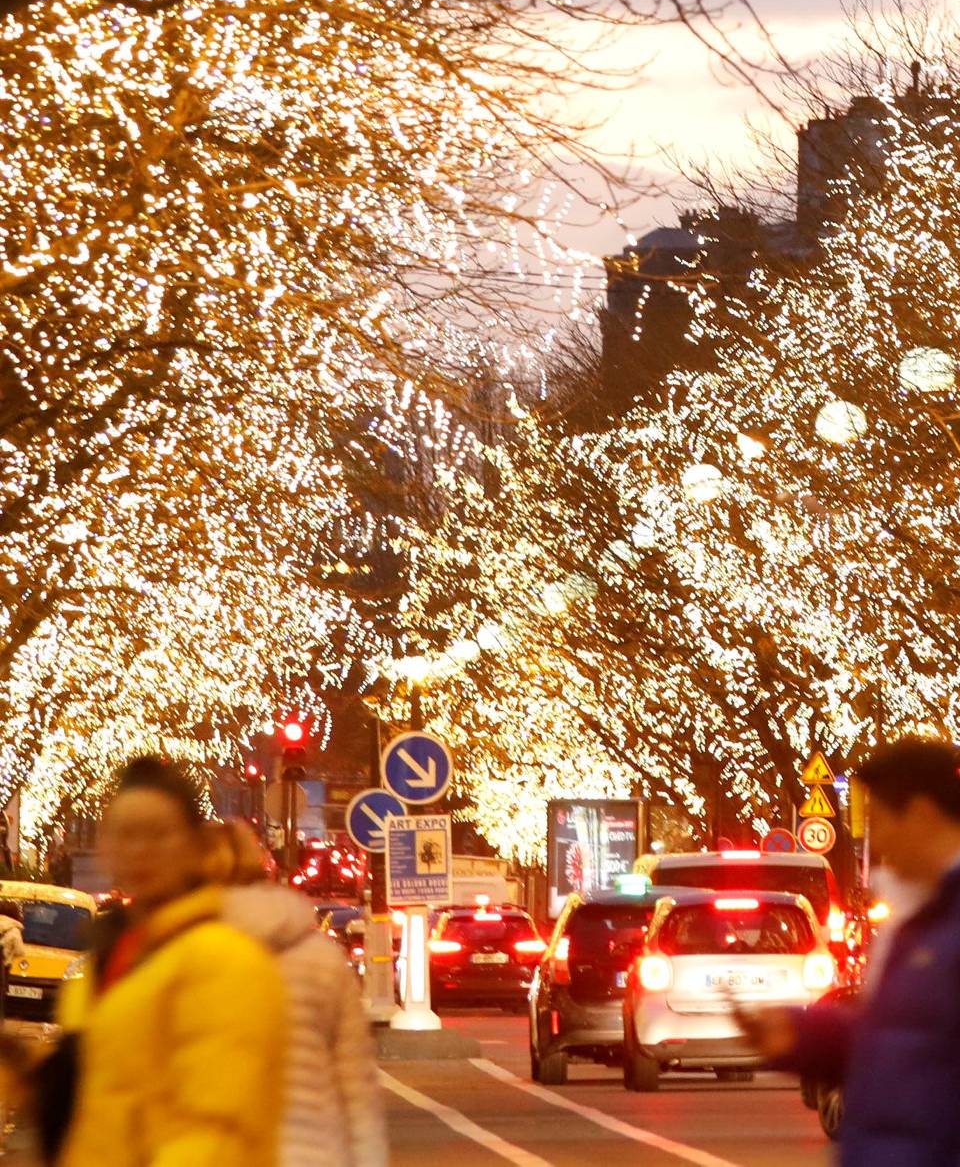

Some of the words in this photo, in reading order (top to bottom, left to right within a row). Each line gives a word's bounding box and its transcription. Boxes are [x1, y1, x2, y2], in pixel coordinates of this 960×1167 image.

[390, 819, 412, 830] ART
[416, 818, 446, 829] EXPO
[807, 828, 827, 843] 30
